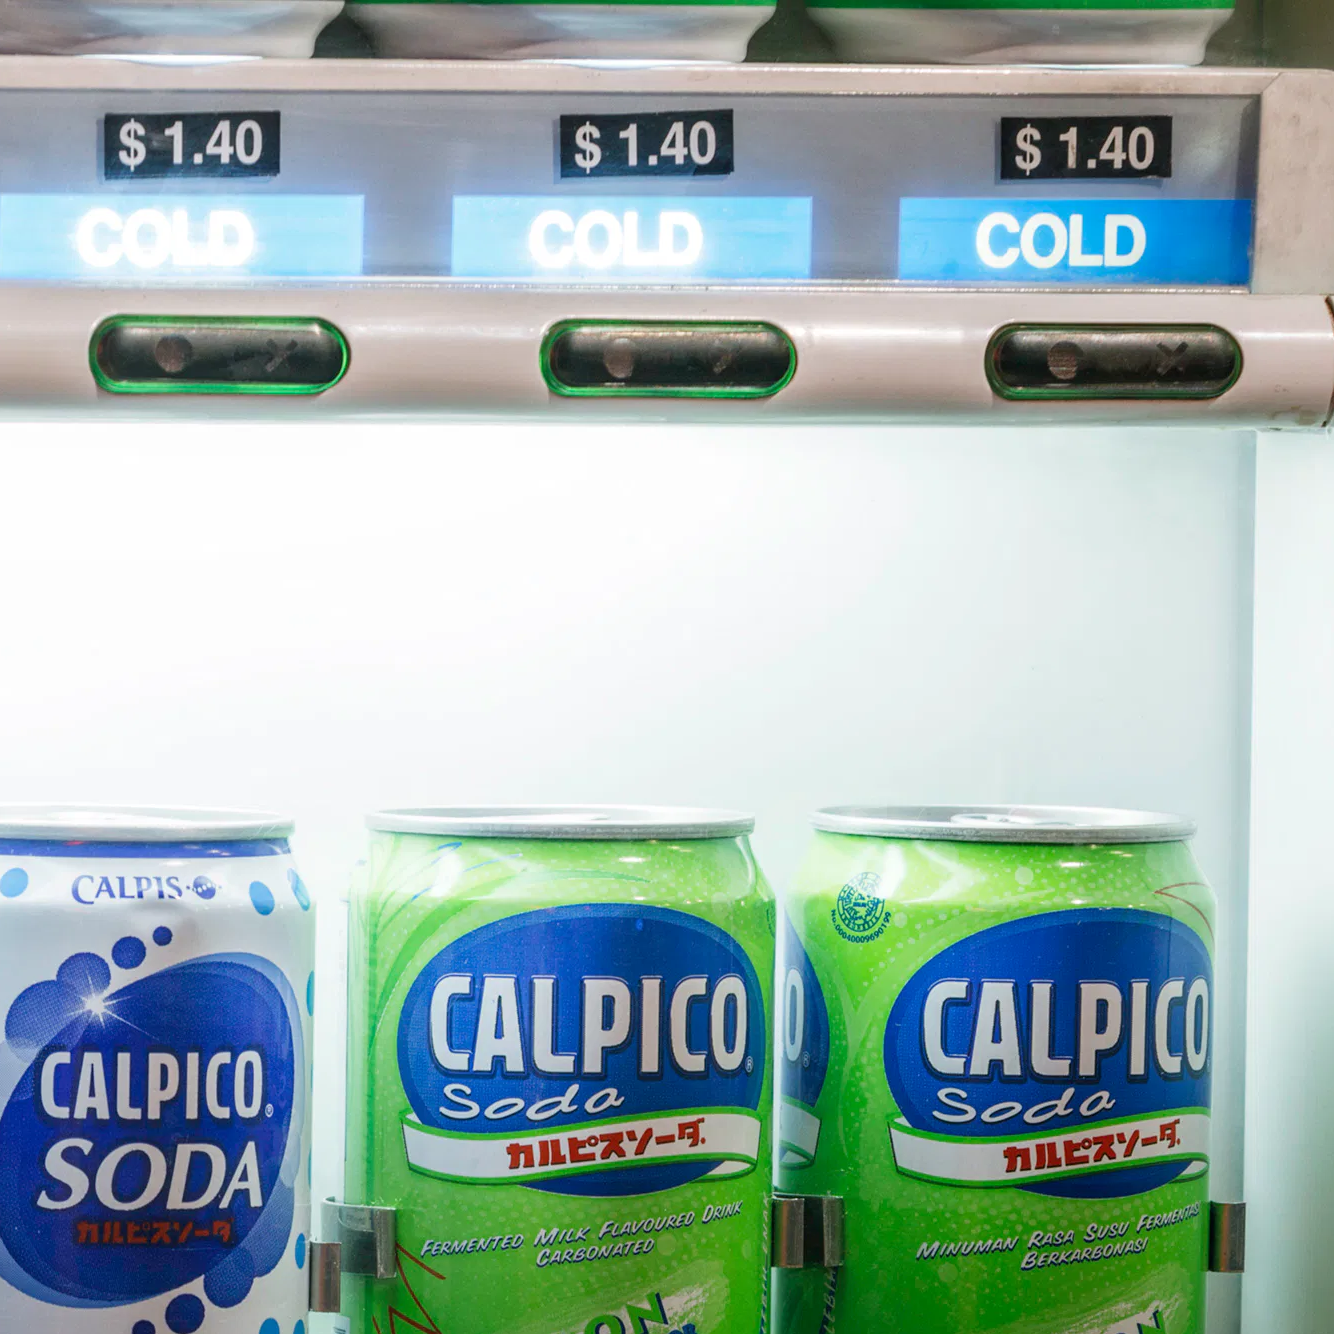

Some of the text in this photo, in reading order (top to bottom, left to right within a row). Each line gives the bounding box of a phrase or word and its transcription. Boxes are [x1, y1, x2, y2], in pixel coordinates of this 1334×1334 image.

[118, 119, 264, 170] $ 1.40
[574, 121, 717, 173] $ 1.40
[1015, 125, 1156, 176] $ 1.40
[76, 209, 255, 268] COLD
[529, 210, 703, 268] COLD
[975, 212, 1147, 268] COLD
[72, 874, 181, 905] CALPIS
[427, 972, 749, 1077] CALPICO
[921, 978, 1210, 1080] CALPICO
[40, 1049, 264, 1120] CALPICO
[439, 1083, 625, 1121] Soda
[932, 1087, 1116, 1124] Soda
[505, 1118, 707, 1170] カルピスソーダ
[1003, 1118, 1181, 1173] カルピスソーダ
[36, 1137, 264, 1211] SODA
[77, 1217, 235, 1245] カルピスソーダ
[420, 1200, 743, 1257] FERMENTED MILK FLAVOURED DRINK
[536, 1239, 655, 1268] CARBONATED
[916, 1235, 1018, 1260] MINUMAN
[1028, 1230, 1075, 1250] RASA
[1085, 1222, 1130, 1243] SUSU
[1020, 1238, 1148, 1271] BERKARBONASI
